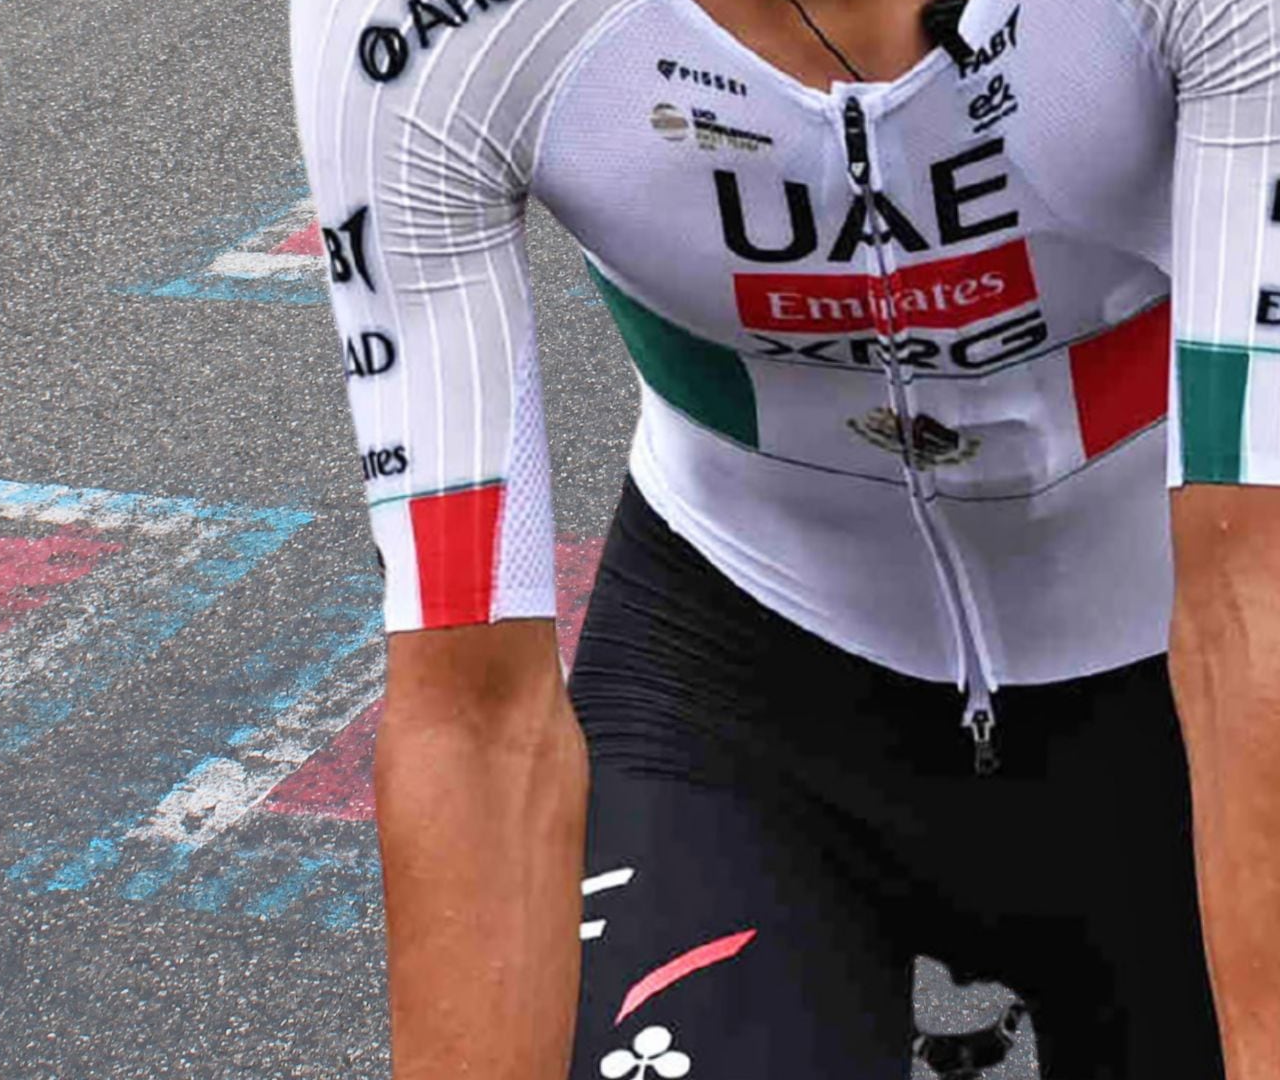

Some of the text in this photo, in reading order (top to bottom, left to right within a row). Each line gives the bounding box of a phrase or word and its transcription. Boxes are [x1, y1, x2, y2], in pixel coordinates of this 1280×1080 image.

[713, 137, 1020, 263] UAE
[767, 271, 1006, 321] Emirates
[754, 309, 1049, 368] XRG
